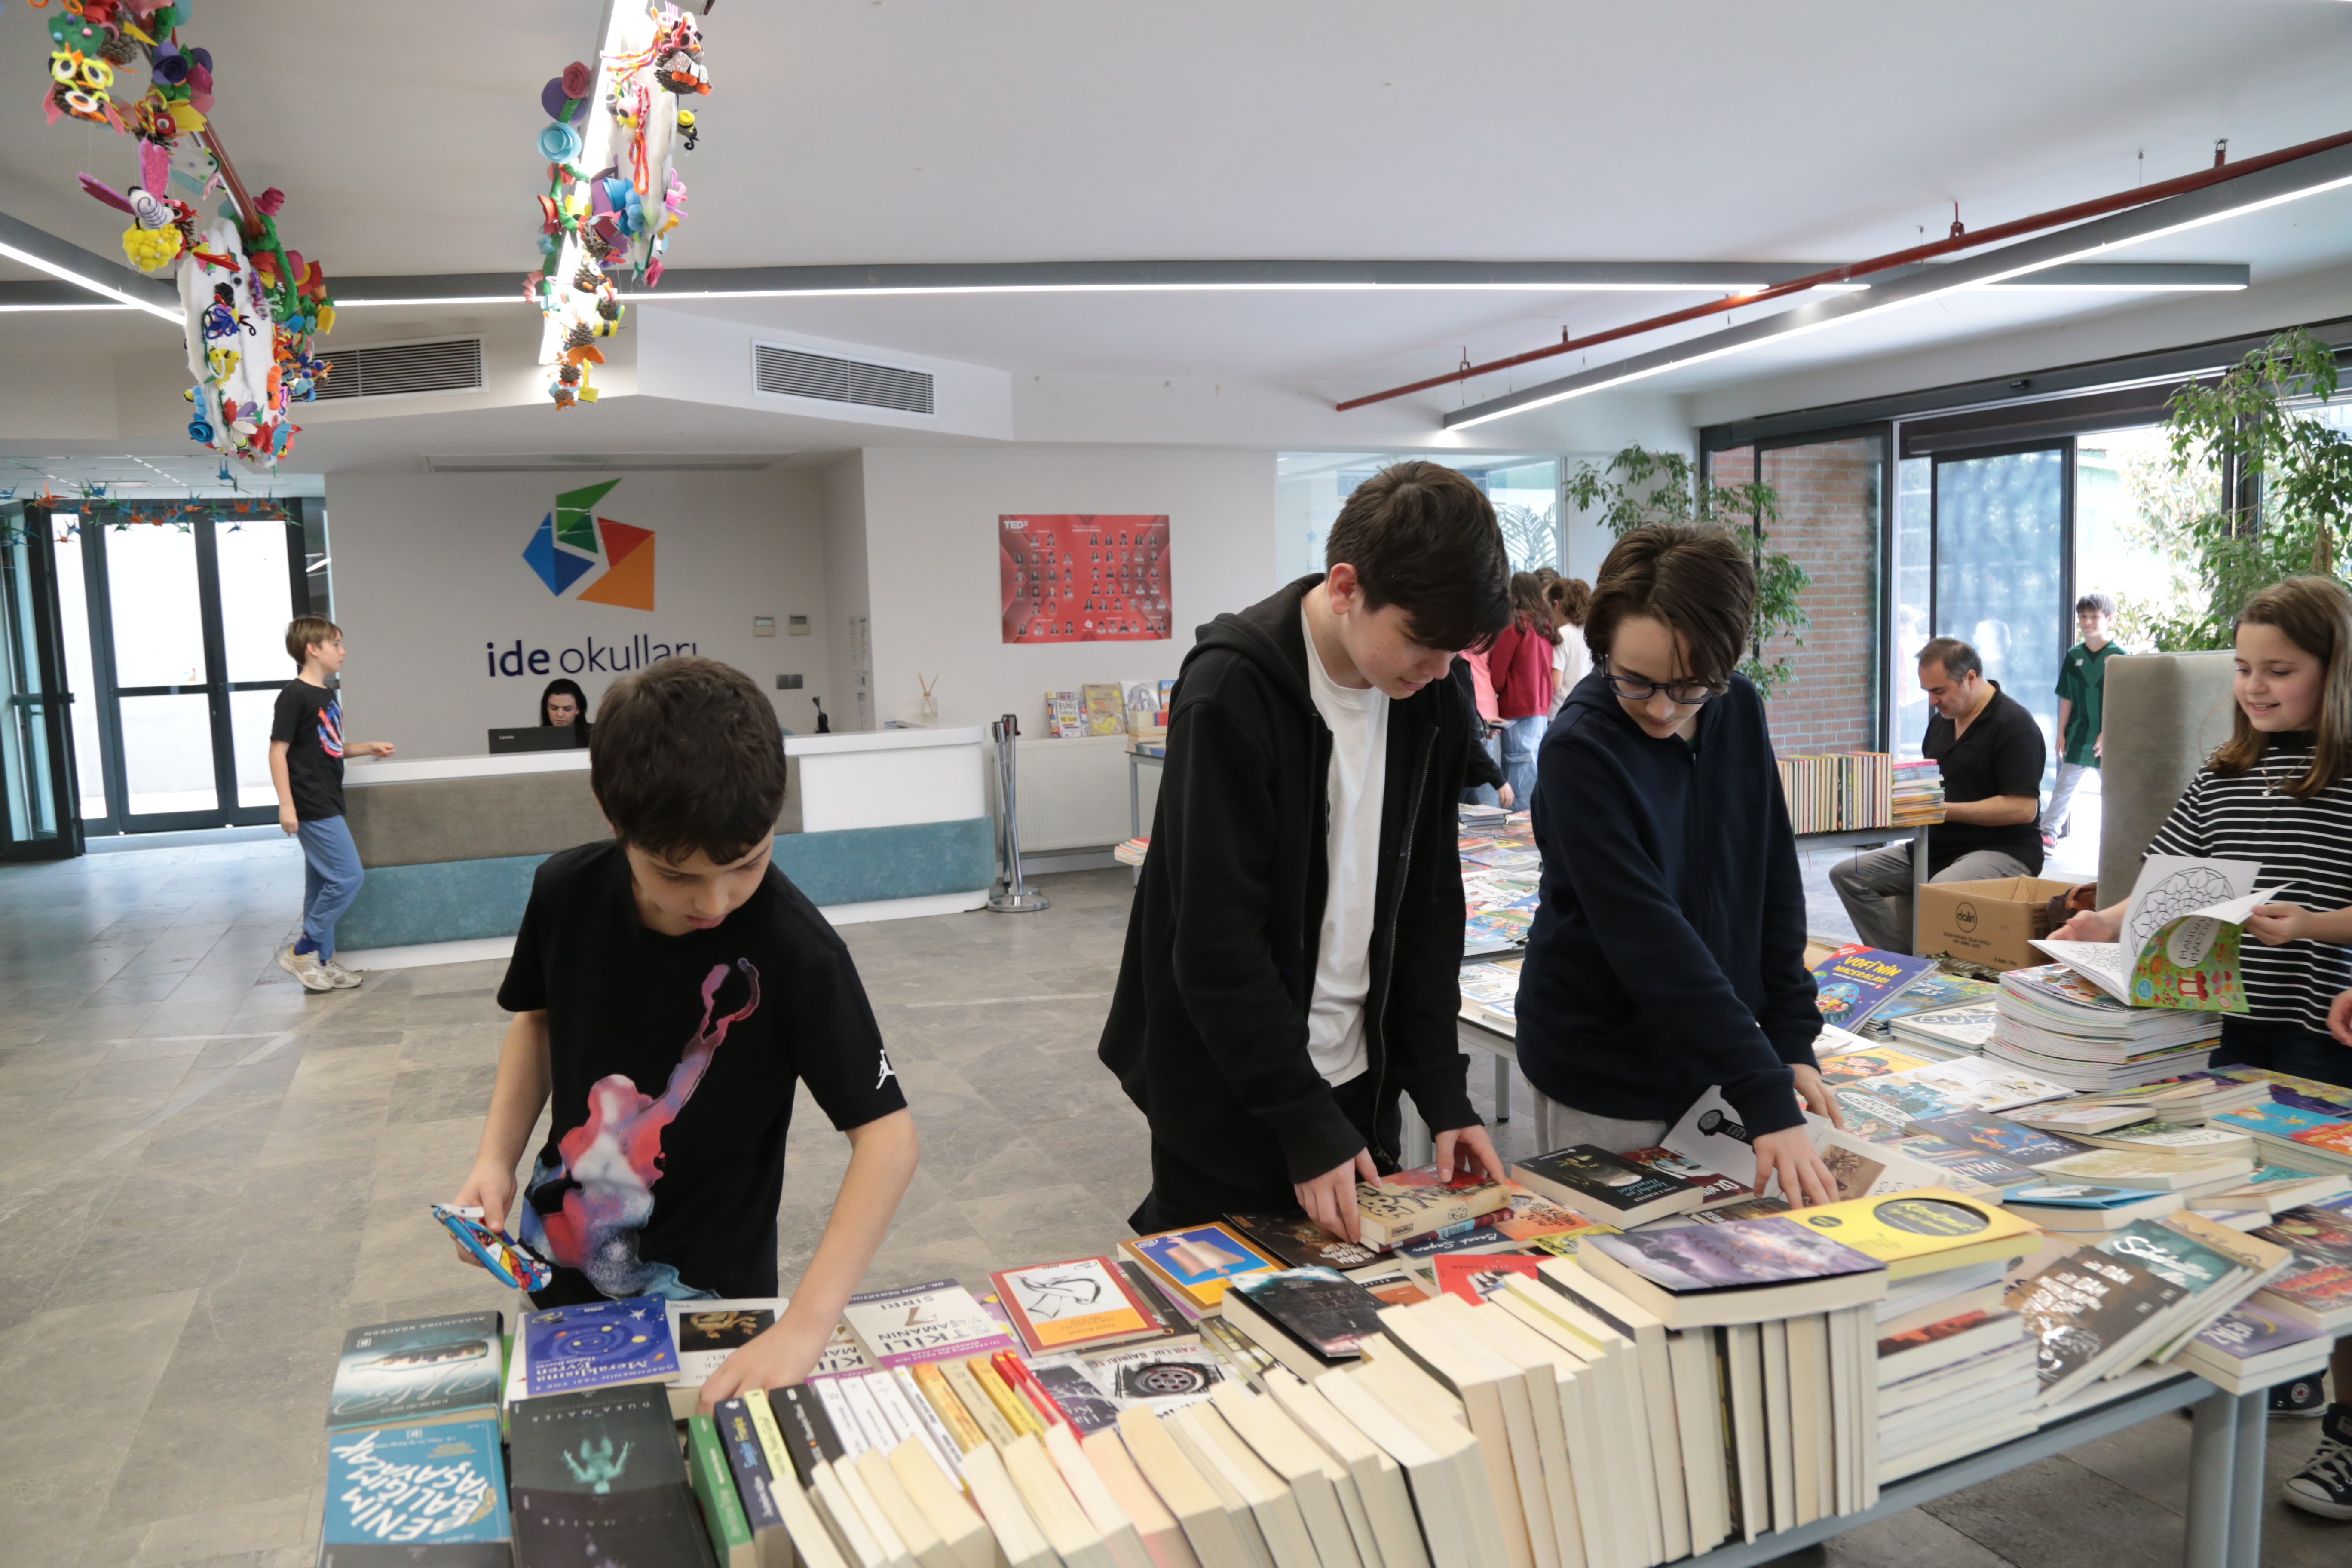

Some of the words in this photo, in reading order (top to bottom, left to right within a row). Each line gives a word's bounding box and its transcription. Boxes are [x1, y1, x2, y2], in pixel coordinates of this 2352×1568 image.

[1004, 521, 1028, 529] TEDx
[486, 640, 550, 677] ide
[1957, 910, 1975, 923] dalin
[2179, 920, 2205, 959] MANDA
[1833, 965, 1891, 984] MACERALARI
[1844, 956, 1902, 977] VOFİ'NİN
[1862, 1098, 1903, 1116] AFETLERE
[1714, 1179, 1740, 1191] OZ
[1392, 1225, 1413, 1237] ORWELL
[1412, 1238, 1455, 1253] Sayan
[902, 1285, 926, 1294] JOHN
[420, 1316, 485, 1329] ALEXANDRA
[904, 1306, 938, 1326] 7
[363, 1325, 415, 1337] BRACKEN
[877, 1317, 982, 1341] YAŞAMANIN
[882, 1325, 991, 1354] ETKİLİ
[1173, 1346, 1199, 1355] JEAN
[536, 1362, 591, 1375] Evren
[536, 1360, 648, 1382] Meraklısına
[346, 1469, 480, 1516] BALIĞIM
[340, 1486, 470, 1541] BENİM
